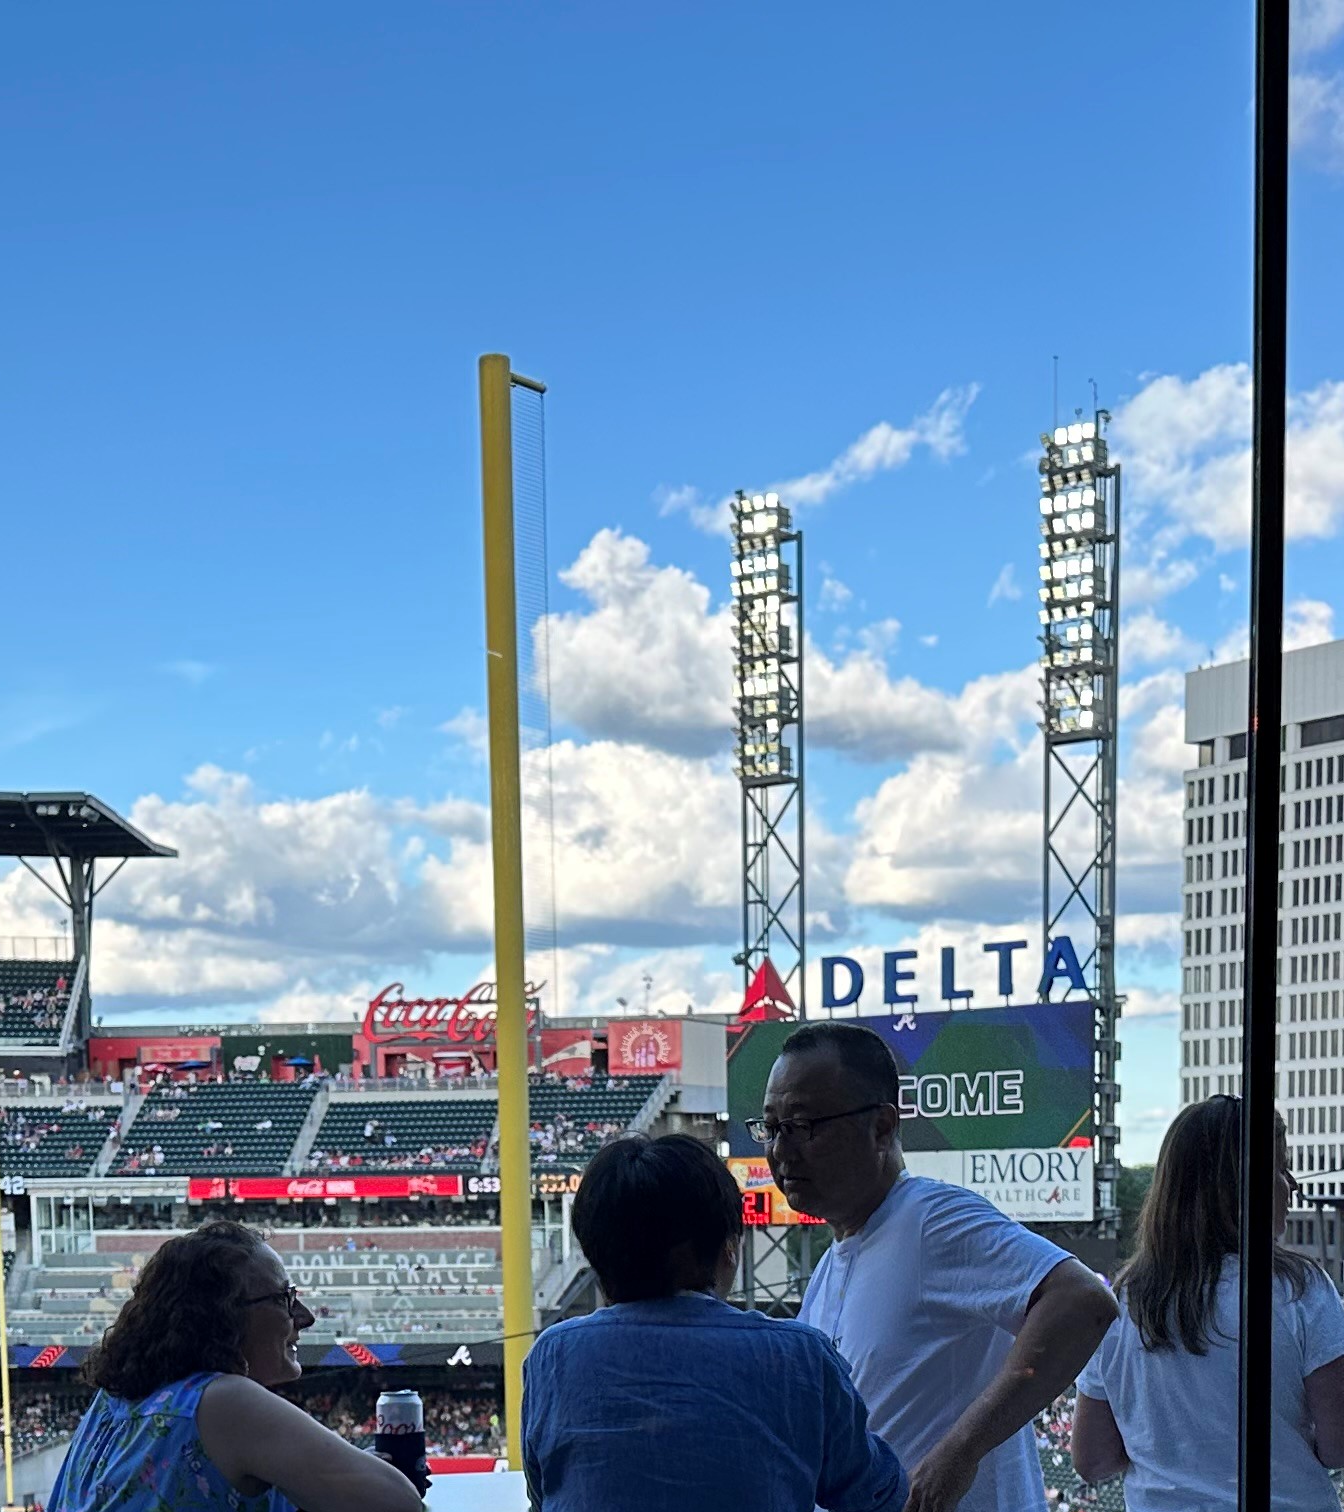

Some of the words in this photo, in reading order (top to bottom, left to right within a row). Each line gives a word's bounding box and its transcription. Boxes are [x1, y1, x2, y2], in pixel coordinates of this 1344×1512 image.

[821, 935, 1088, 1008] DELTA
[363, 977, 547, 1043] Coca-Co
[898, 1069, 1024, 1119] COME
[971, 1152, 1086, 1184] EMORY
[0, 1176, 25, 1196] 42
[468, 1176, 501, 1193] 6:53
[980, 1186, 1082, 1204] EALTHCARE
[352, 1252, 487, 1284] TERRACE
